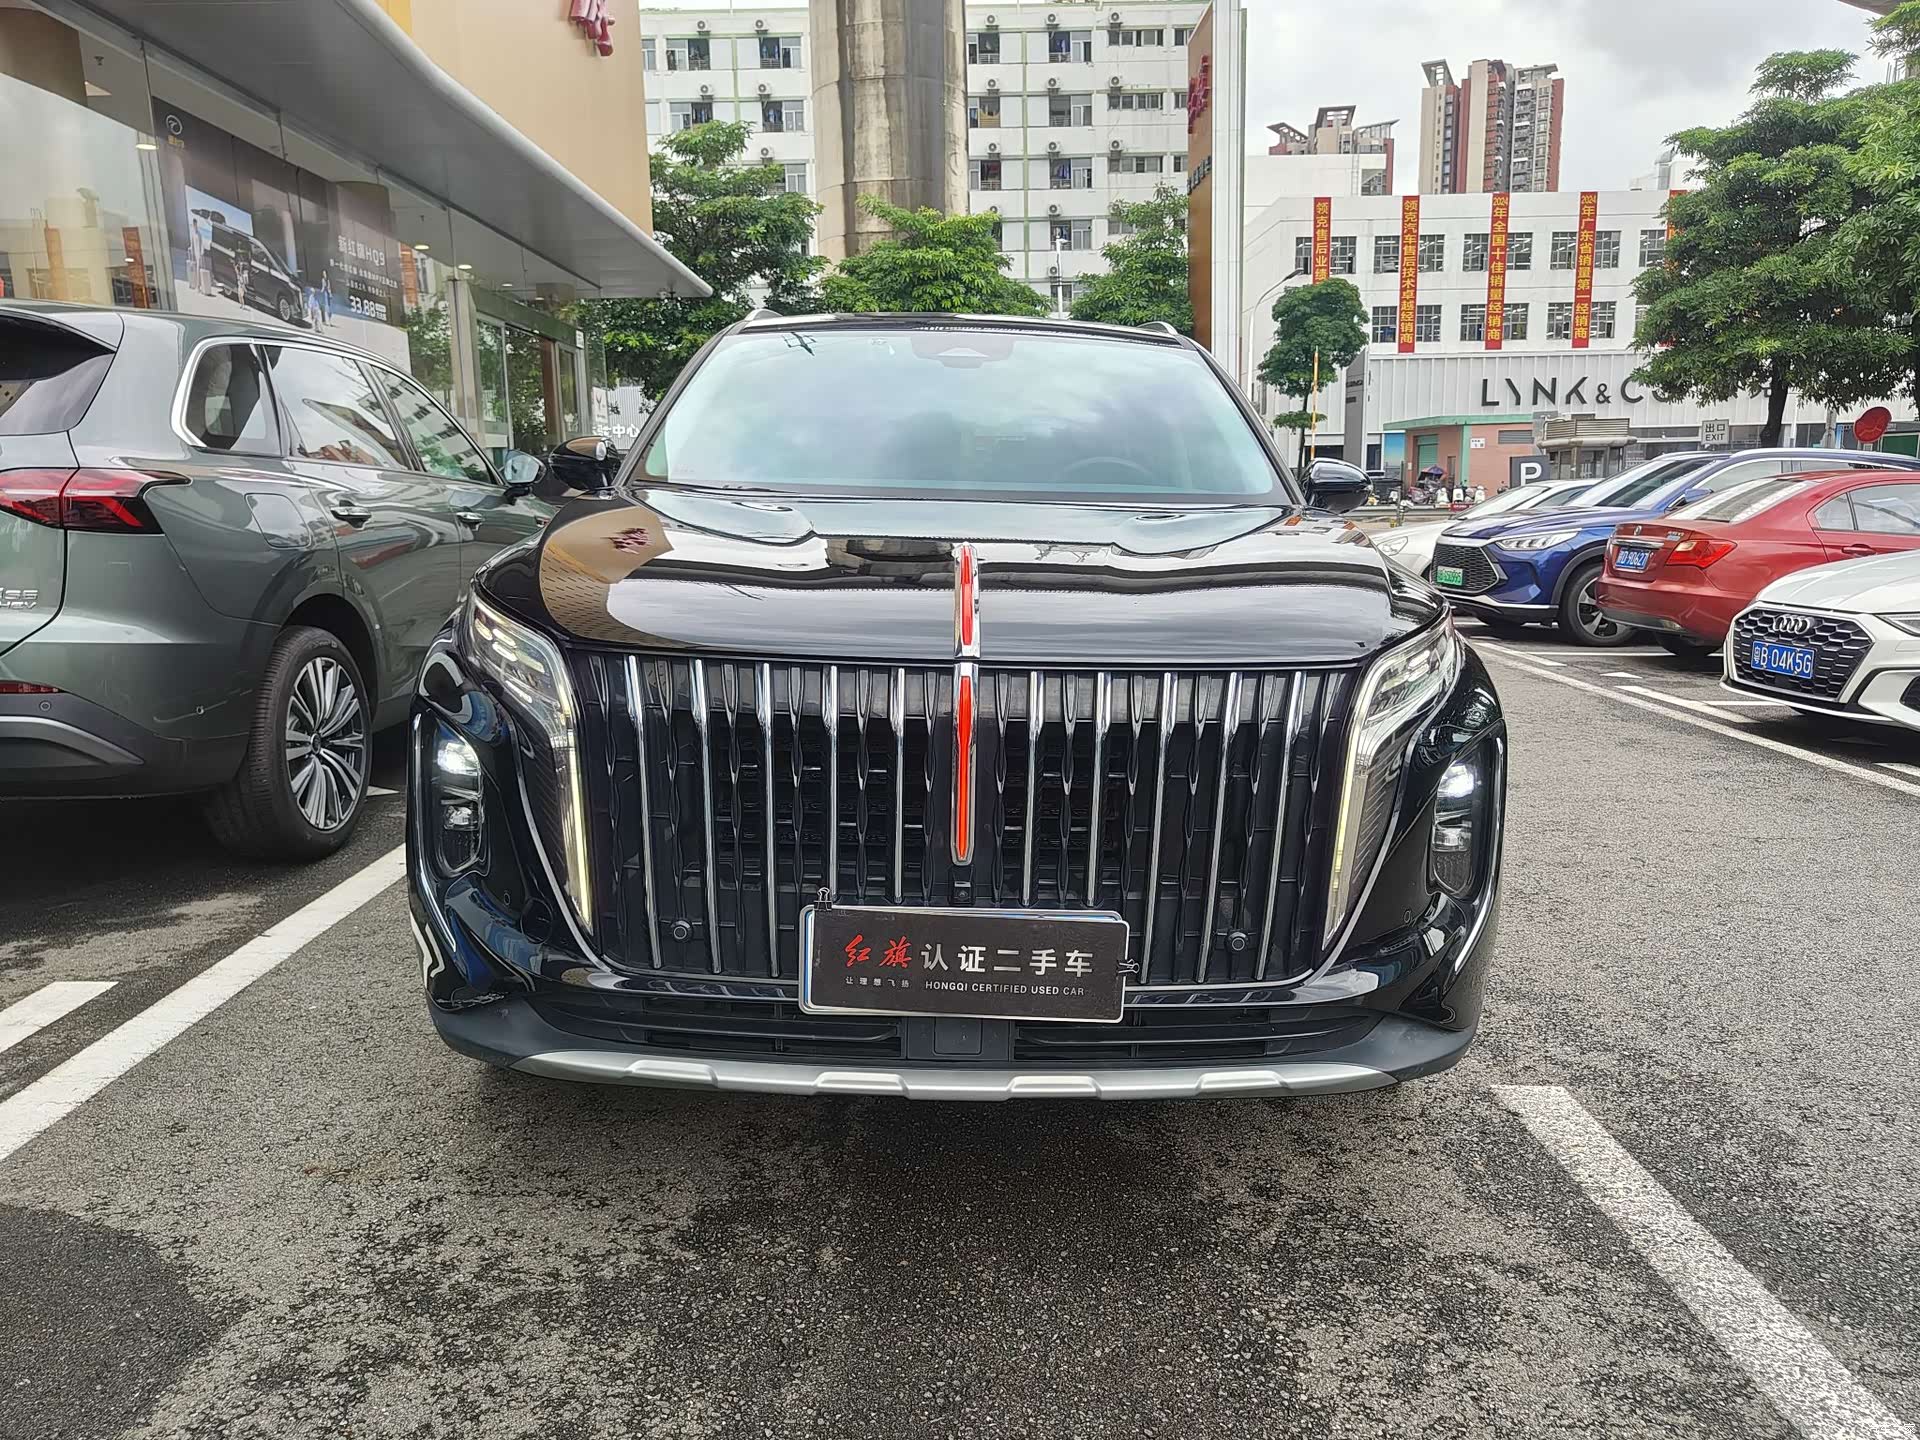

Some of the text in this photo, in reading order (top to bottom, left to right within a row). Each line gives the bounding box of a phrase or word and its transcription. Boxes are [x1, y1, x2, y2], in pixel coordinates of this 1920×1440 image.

[1315, 202, 1329, 285] 领克售后业绩
[1705, 424, 1725, 432] 出口
[1705, 433, 1724, 441] EXIT
[1520, 462, 1542, 486] P
[925, 981, 1084, 996] HONGQI CERTIFIED USED CAR
